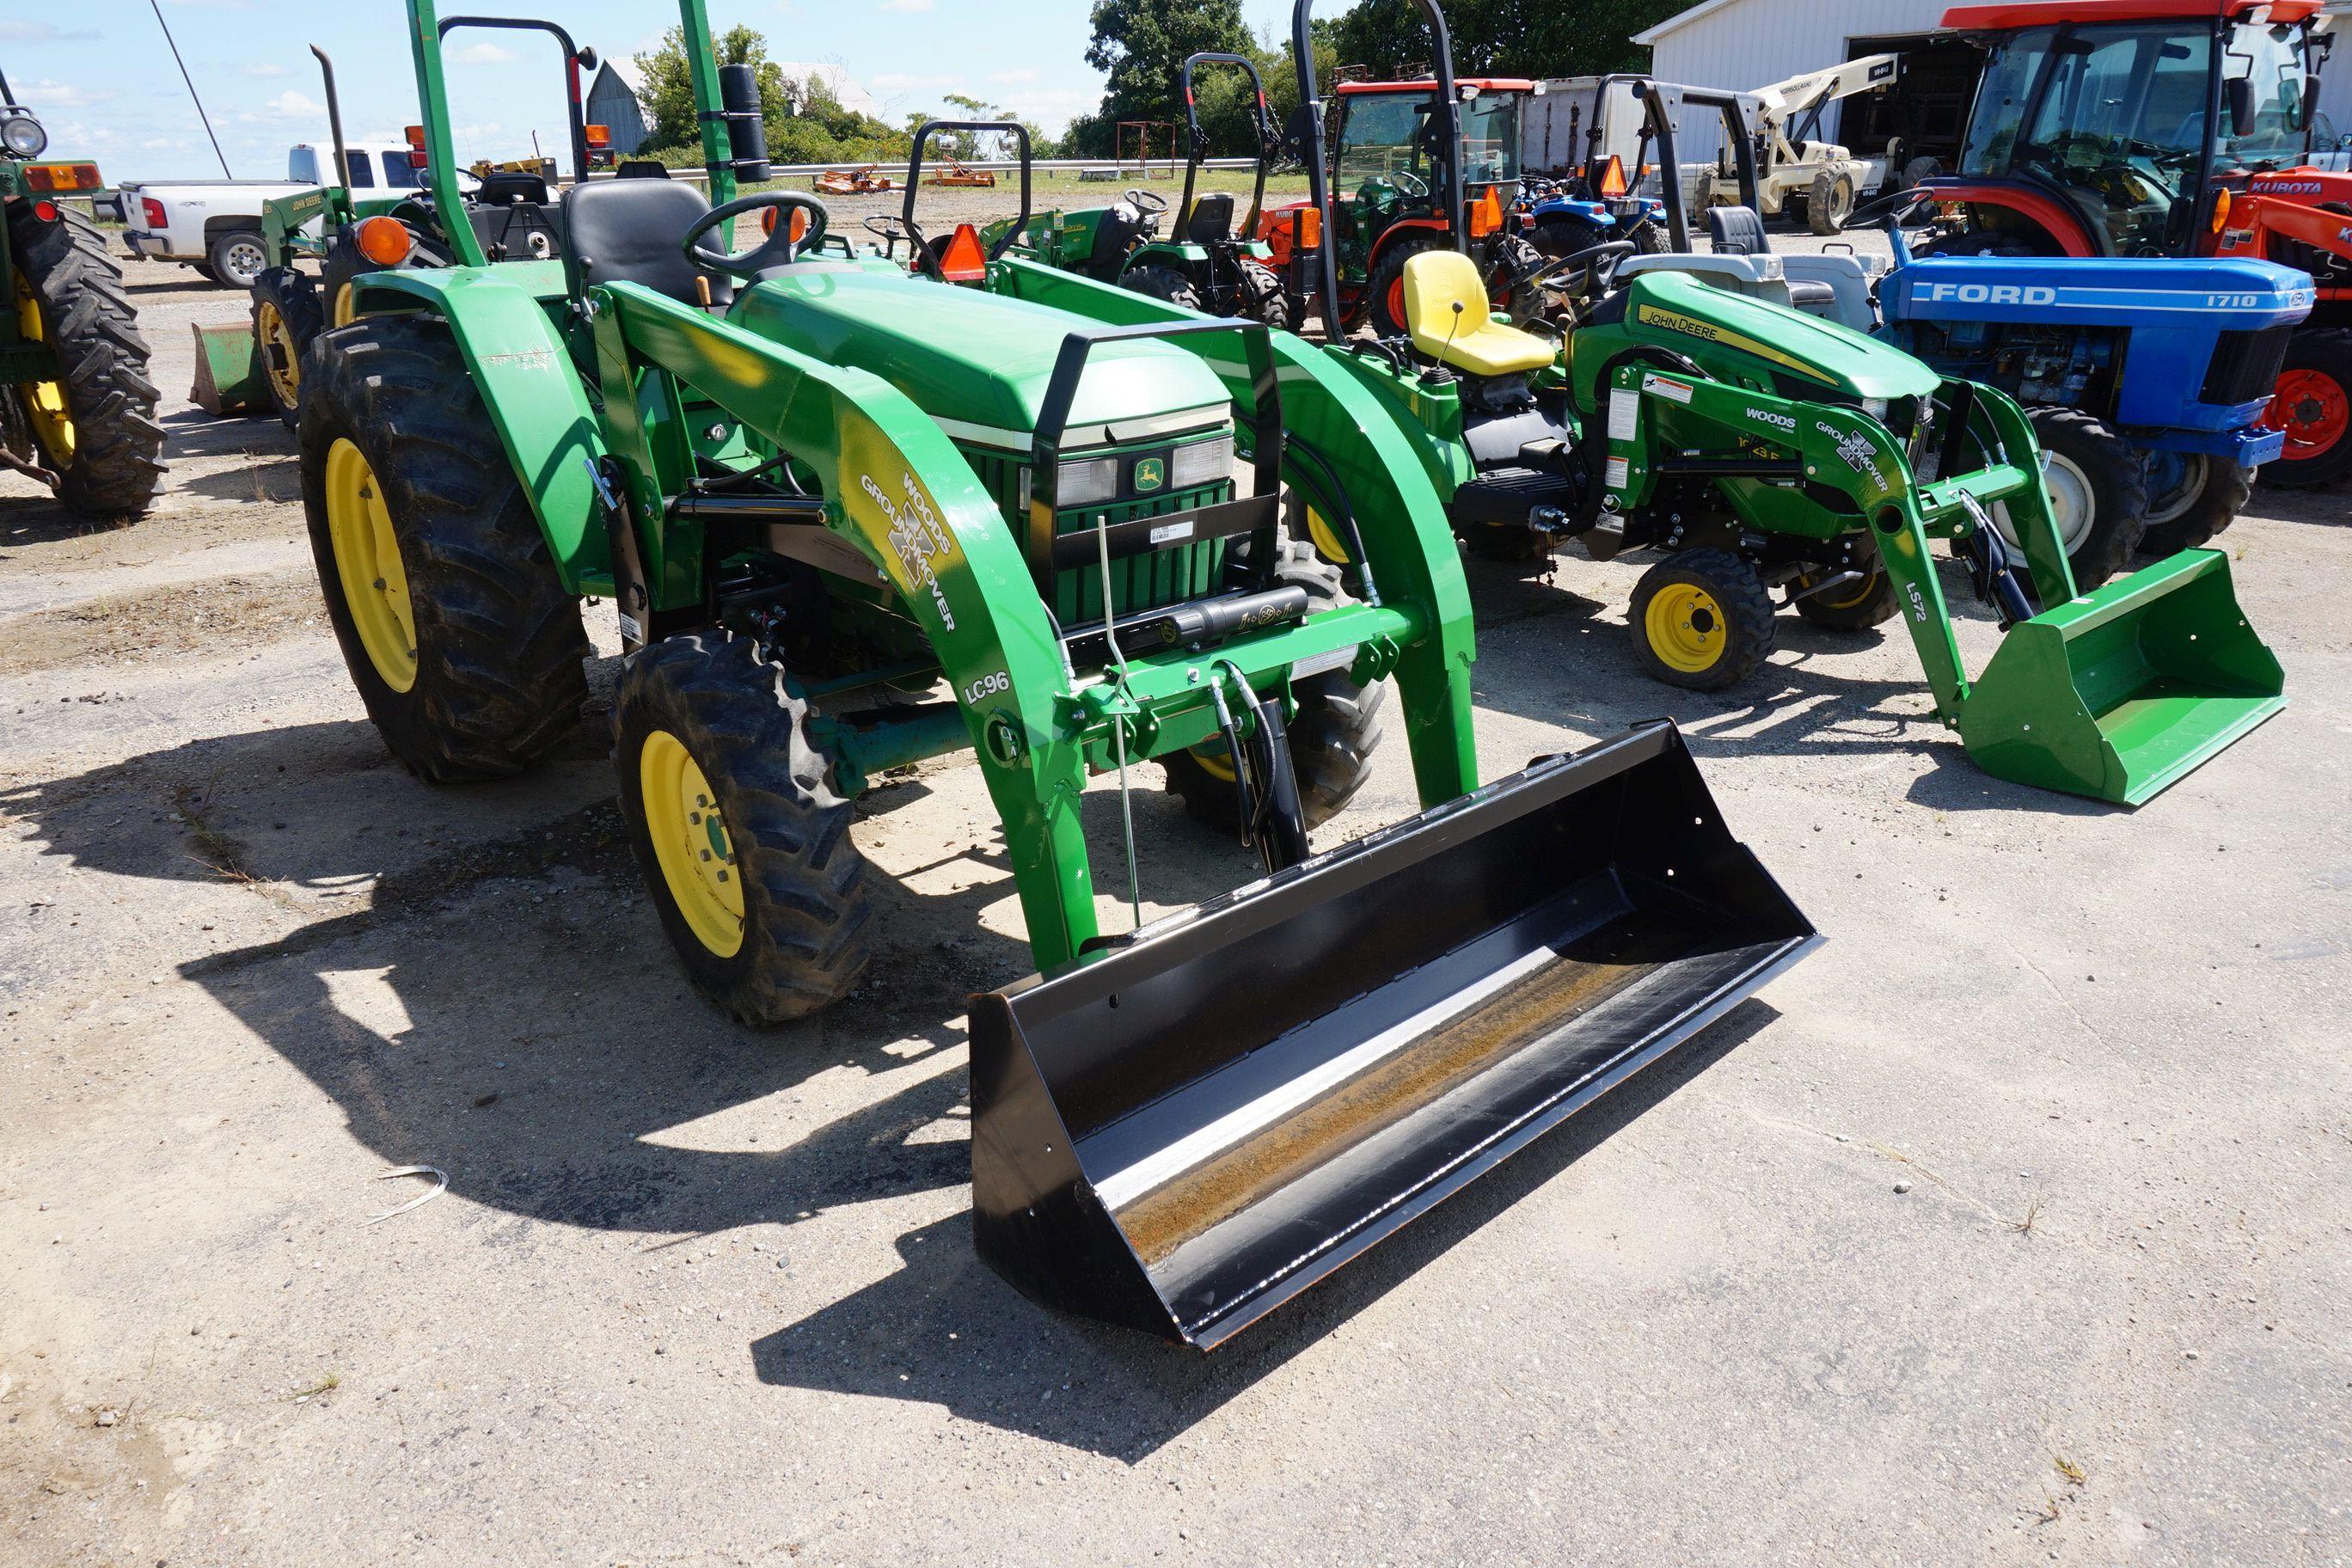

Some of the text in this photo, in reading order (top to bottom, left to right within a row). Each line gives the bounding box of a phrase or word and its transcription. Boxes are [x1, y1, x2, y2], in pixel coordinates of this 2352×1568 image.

[2251, 181, 2322, 195] KUBOTA
[1275, 210, 1293, 218] KUBO
[1932, 283, 2056, 305] FORD
[2207, 295, 2258, 308] 1710
[1645, 311, 1718, 339] JOHN DEERE
[1746, 407, 1797, 429] WOODS
[1815, 420, 1890, 493] GROUNDMOVER
[903, 471, 952, 555] WOODS
[861, 473, 956, 633] GROUNDMOVER
[1905, 581, 1927, 623] LS72
[964, 671, 1010, 706] LC96
